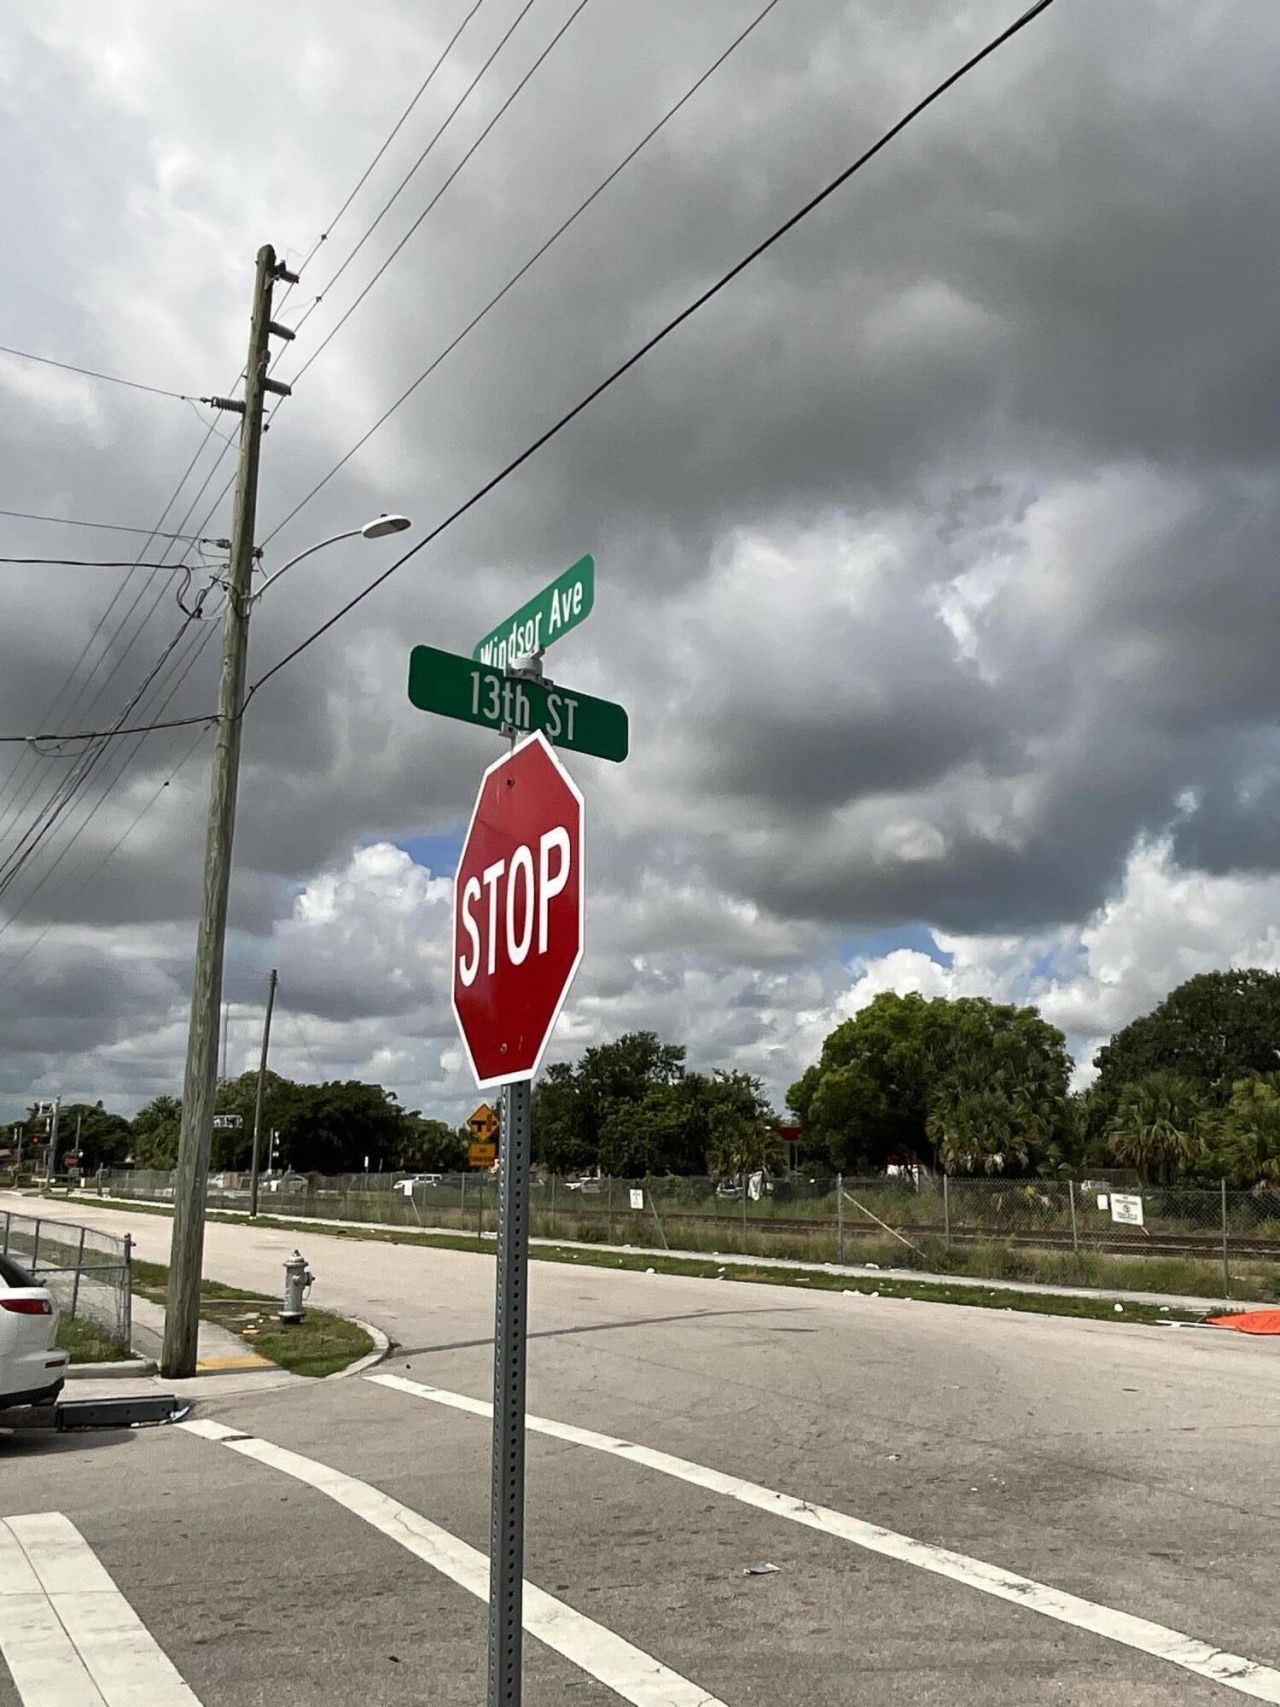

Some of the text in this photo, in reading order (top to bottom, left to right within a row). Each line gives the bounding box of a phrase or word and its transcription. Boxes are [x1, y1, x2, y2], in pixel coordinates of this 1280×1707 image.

[481, 581, 582, 669] Windsor Ave
[470, 671, 578, 740] 13th ST
[459, 826, 571, 987] STOP
